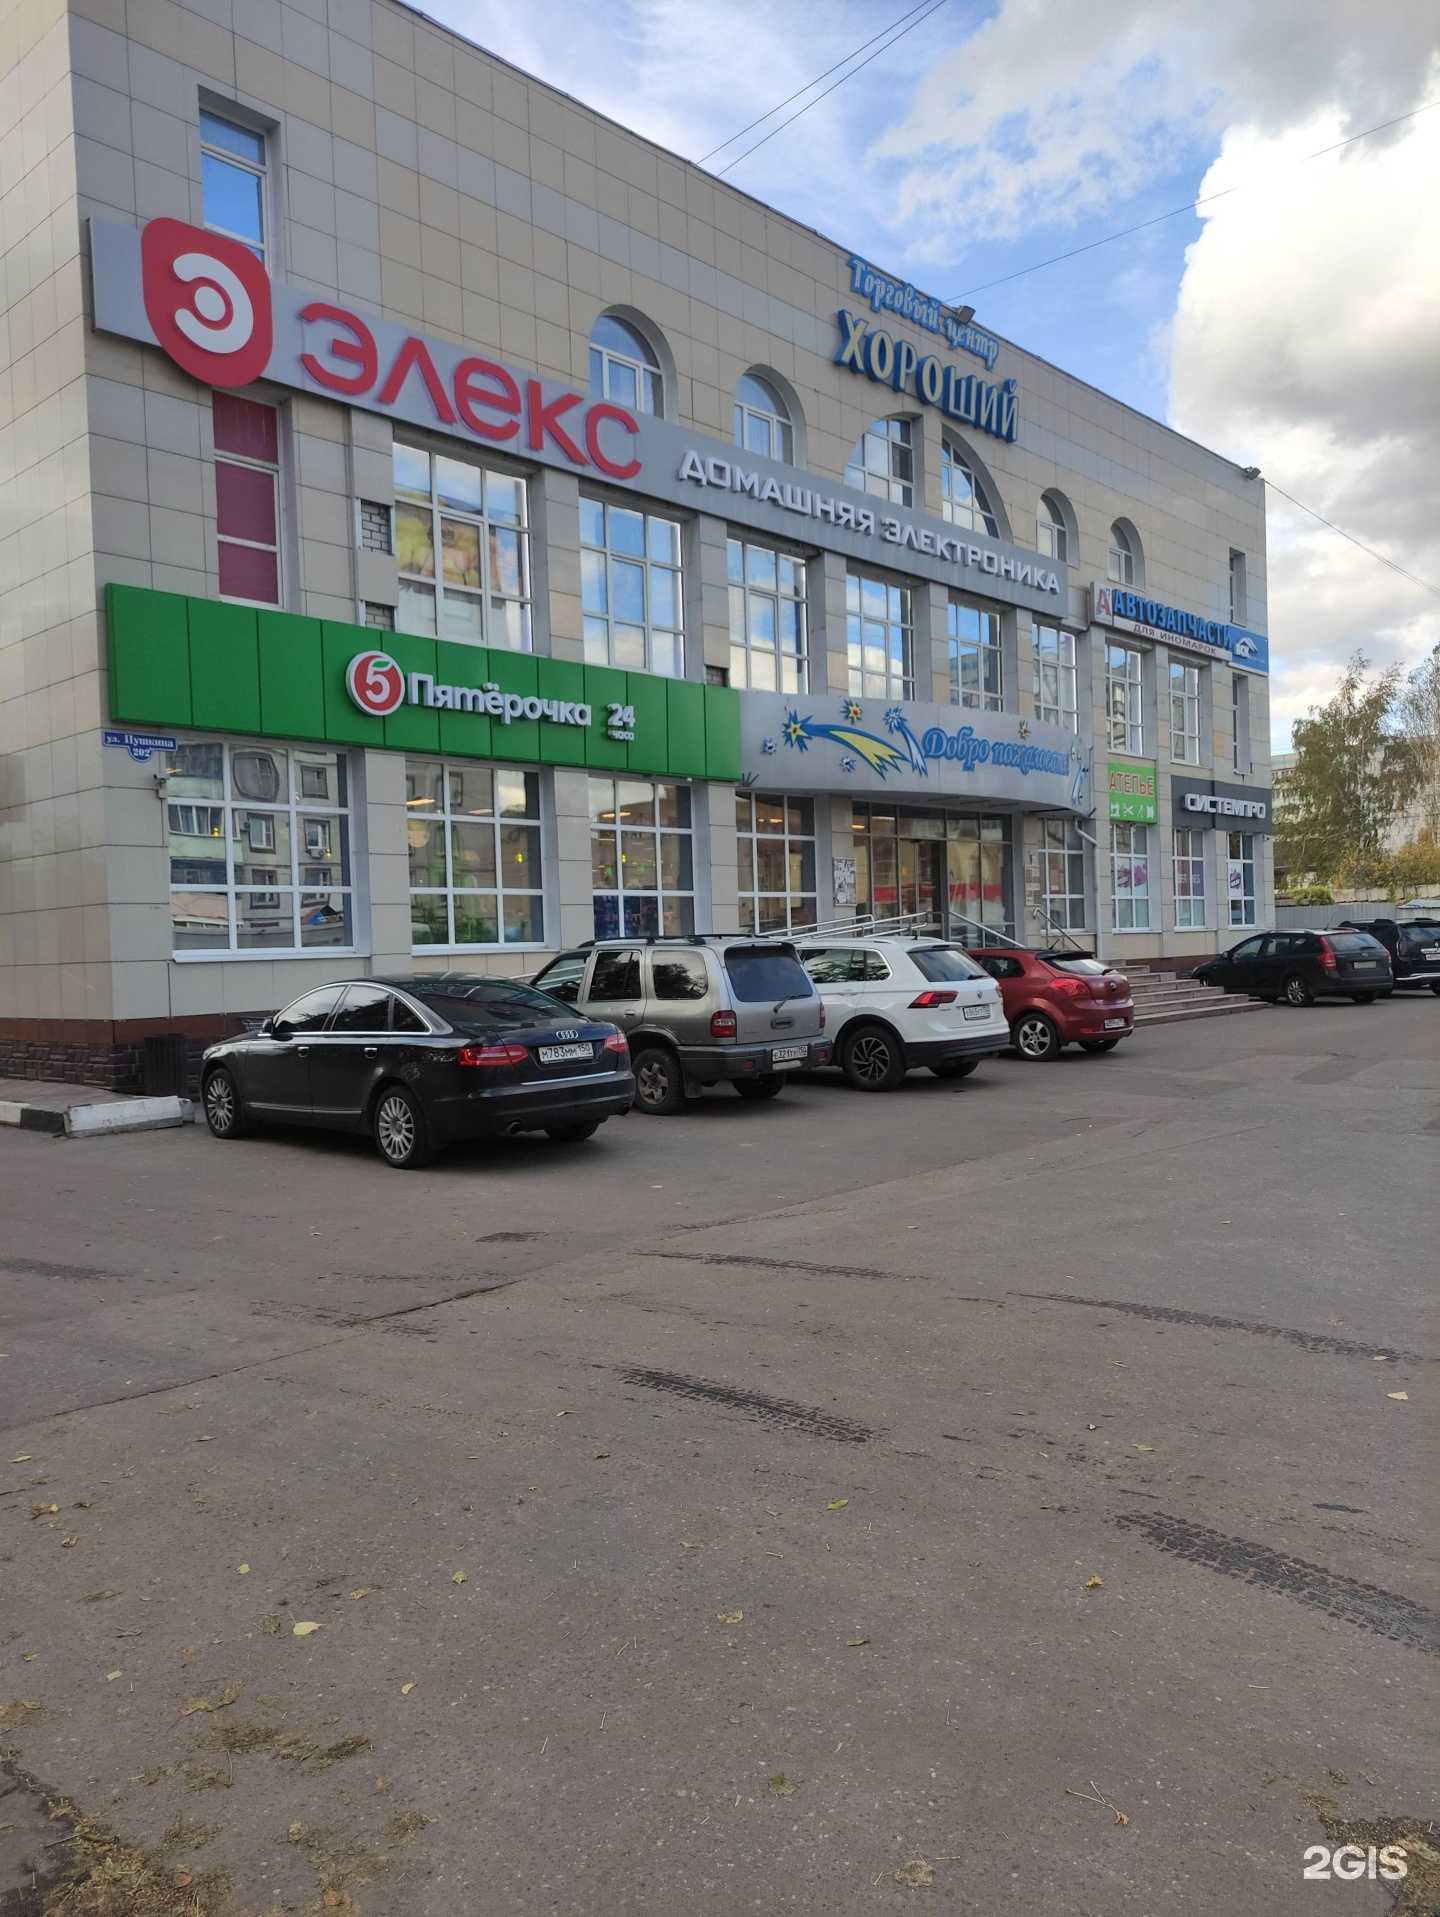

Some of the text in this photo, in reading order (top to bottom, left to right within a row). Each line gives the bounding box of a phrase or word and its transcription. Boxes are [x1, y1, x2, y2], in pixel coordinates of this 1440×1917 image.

[849, 255, 999, 371] Торговый центр
[834, 308, 1020, 444] ХОРОШИЙ
[677, 449, 1061, 596] ДОМАШНЯЯ ЭЛЕКТРОНИКА
[1113, 588, 1232, 649] АВТОЗАПЧАСТИ
[407, 671, 592, 727] Пятёрочка
[607, 703, 635, 727] 24
[124, 734, 174, 748] Пушкина
[133, 747, 151, 757] 202
[922, 726, 991, 772] Добро
[1183, 793, 1267, 819] СИСТЕМПРО
